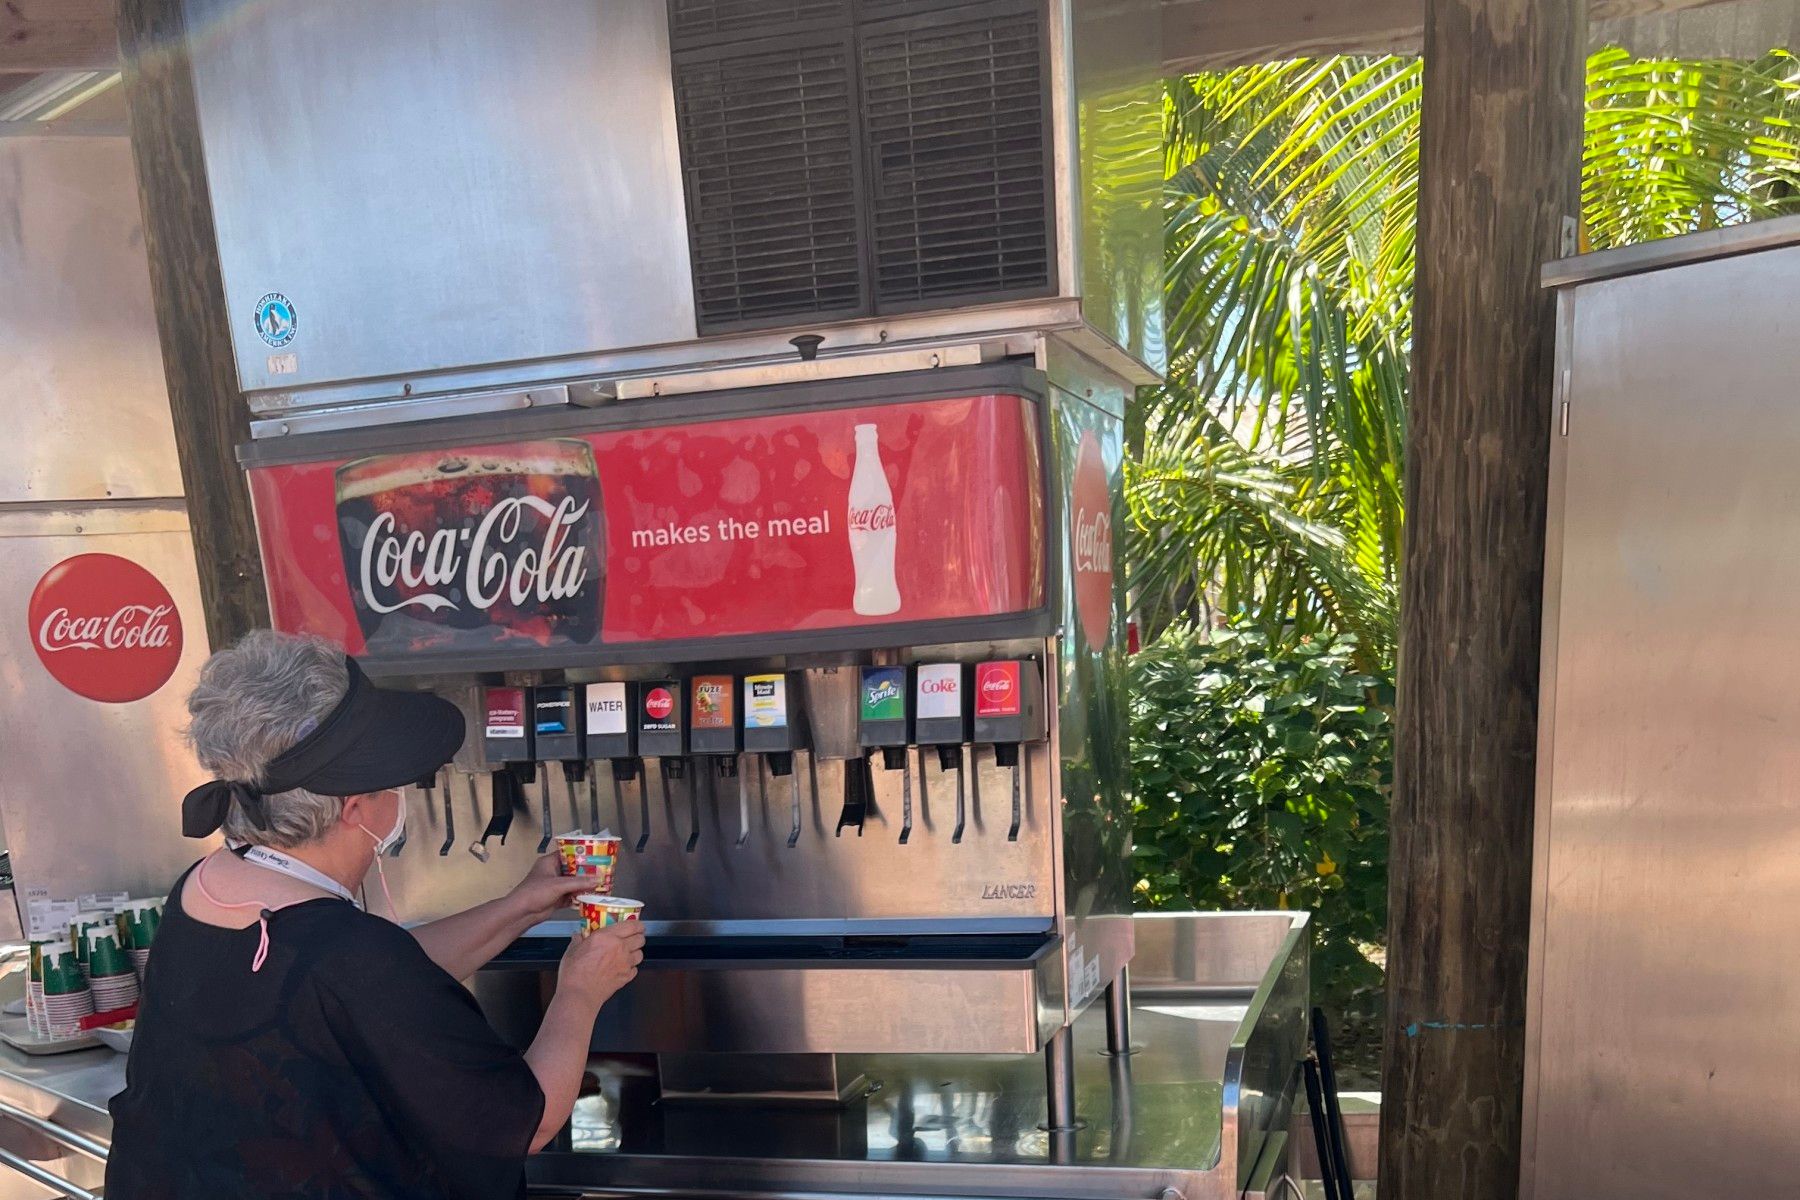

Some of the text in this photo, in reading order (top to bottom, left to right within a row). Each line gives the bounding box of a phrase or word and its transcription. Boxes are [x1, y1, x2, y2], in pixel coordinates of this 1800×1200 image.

[631, 510, 830, 547] makes the meal
[360, 495, 590, 613] Coca-Cola
[39, 604, 173, 652] Coca-Cola
[921, 679, 957, 694] Coke
[983, 679, 1010, 692] Coca-Cola
[868, 687, 897, 704] Sprite
[589, 700, 623, 713] WATER
[981, 884, 1036, 900] LANCER
